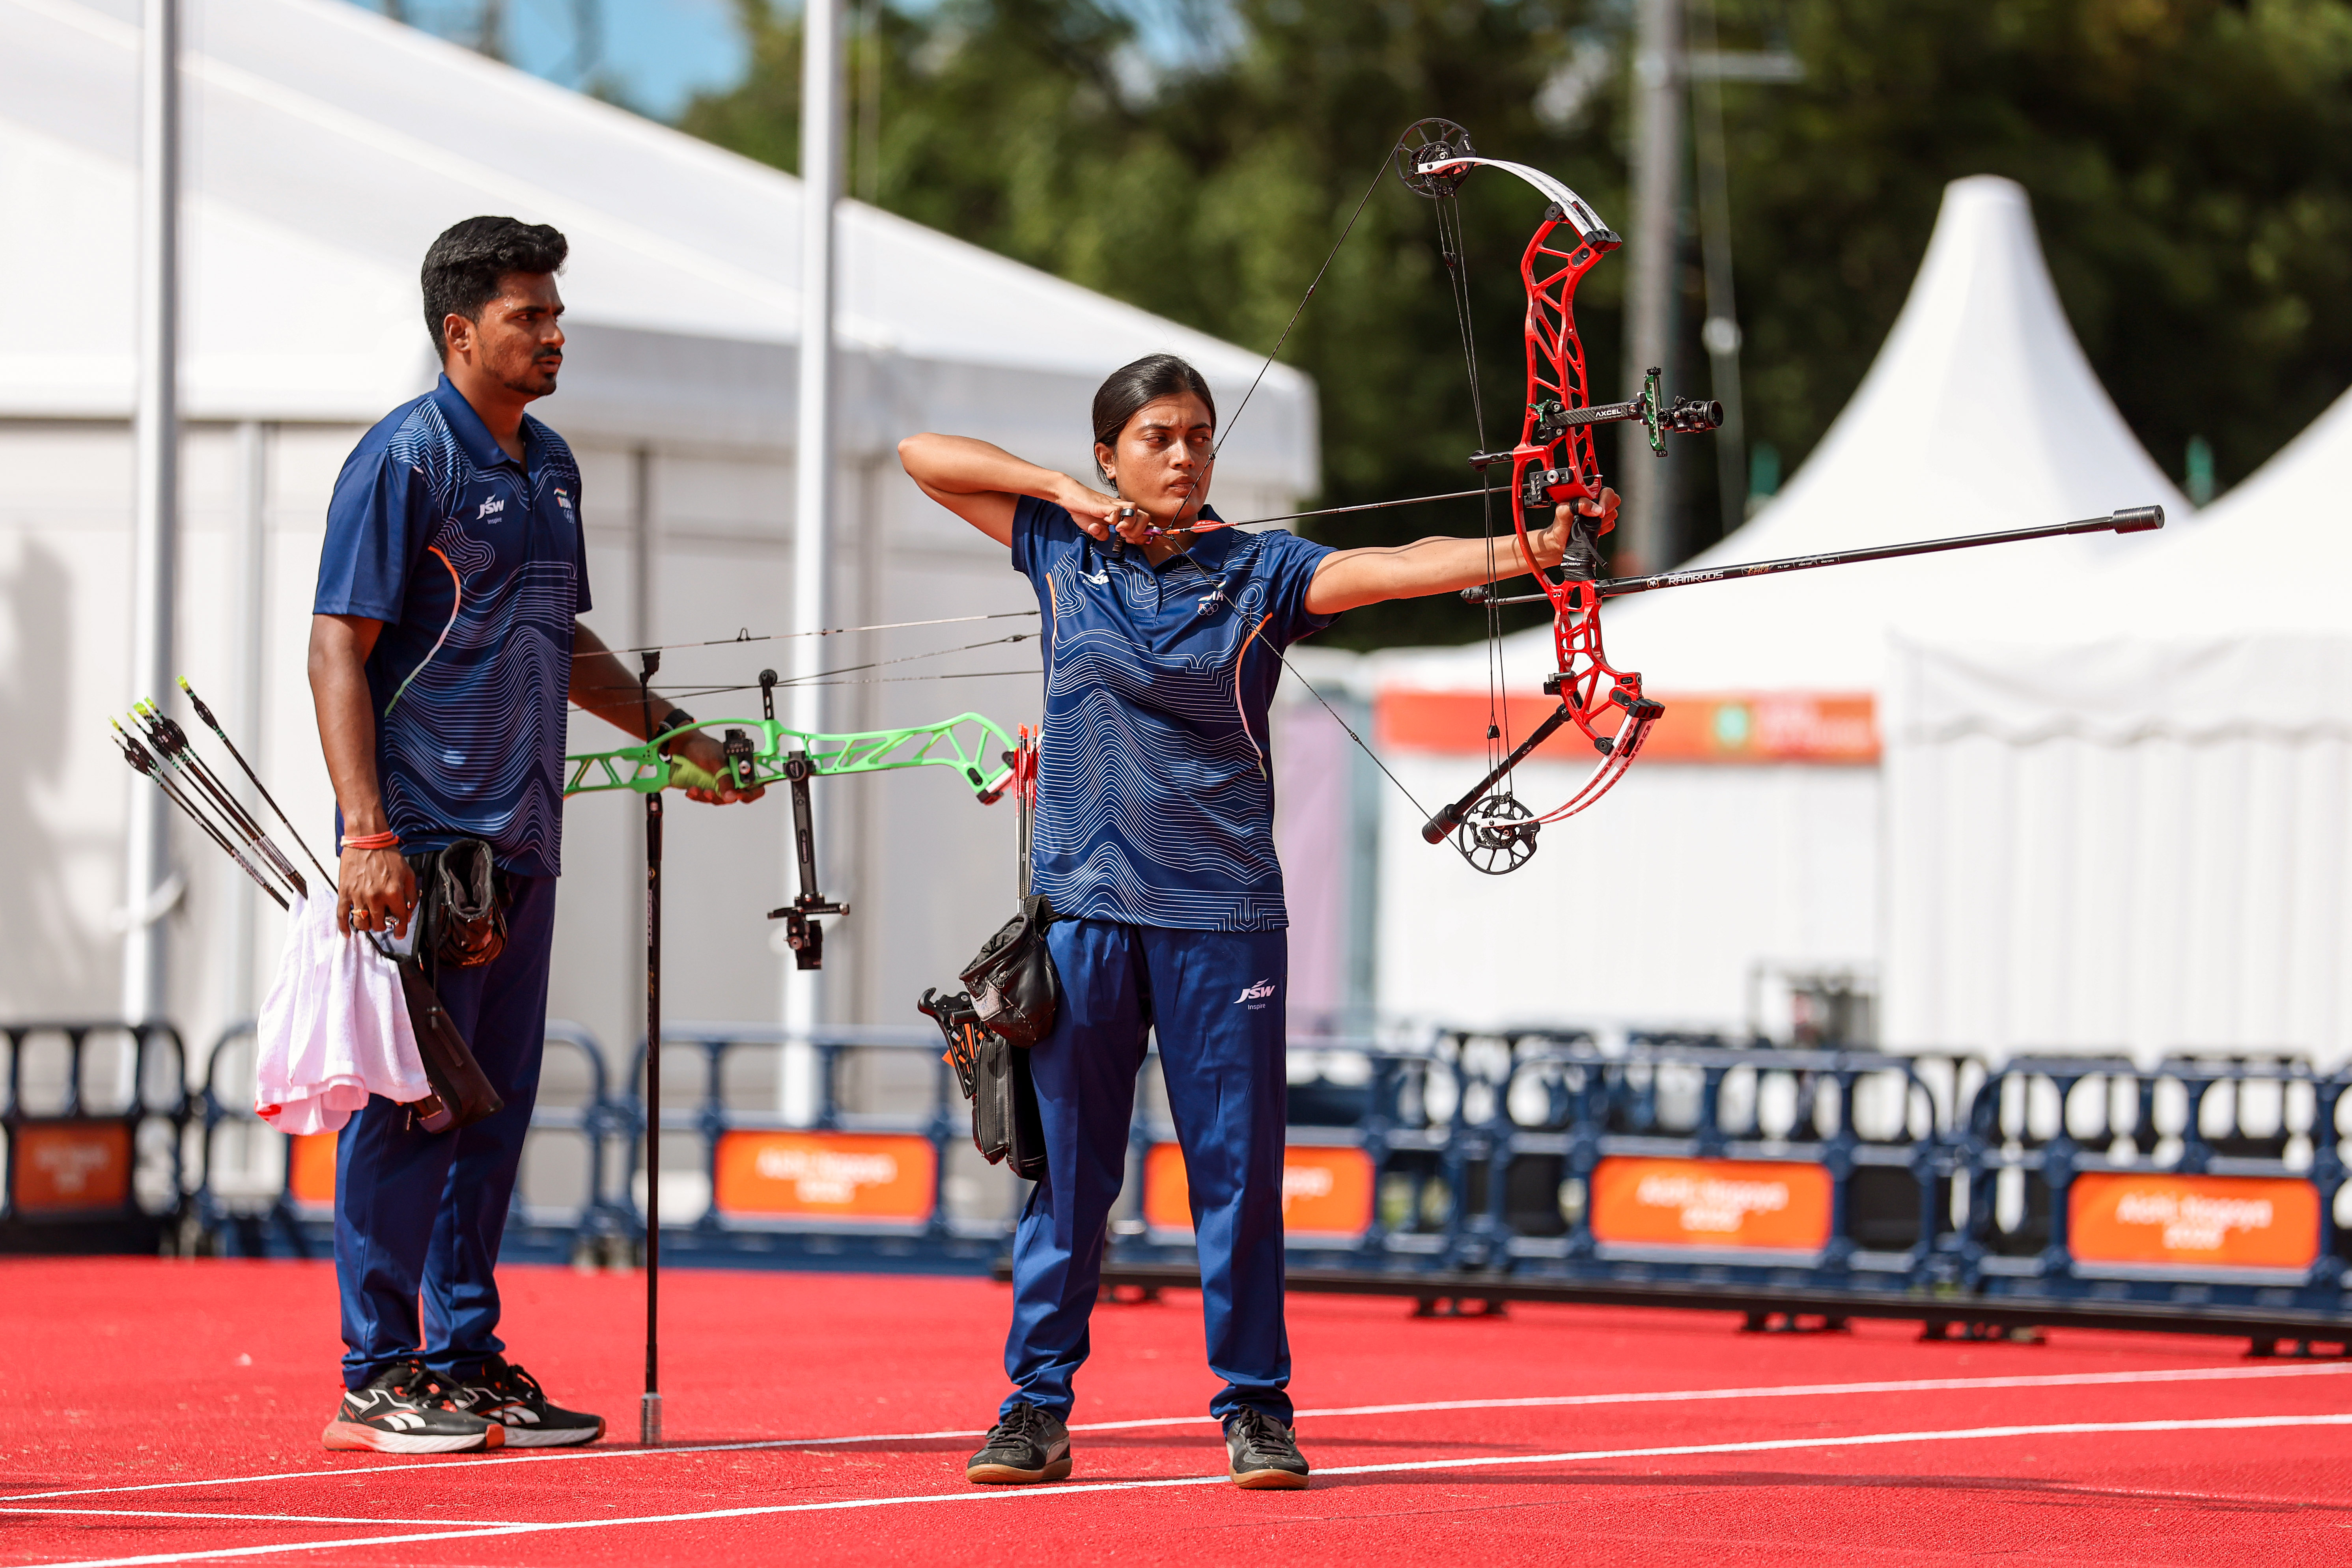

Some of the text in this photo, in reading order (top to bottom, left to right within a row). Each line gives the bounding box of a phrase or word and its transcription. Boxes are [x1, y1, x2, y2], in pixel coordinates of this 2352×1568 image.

[1595, 409, 1621, 418] AXCEL
[476, 499, 505, 520] JSW
[1082, 578, 1100, 591] Inspire
[1668, 571, 1724, 586] RAMRODS
[1233, 985, 1276, 1004] JSW
